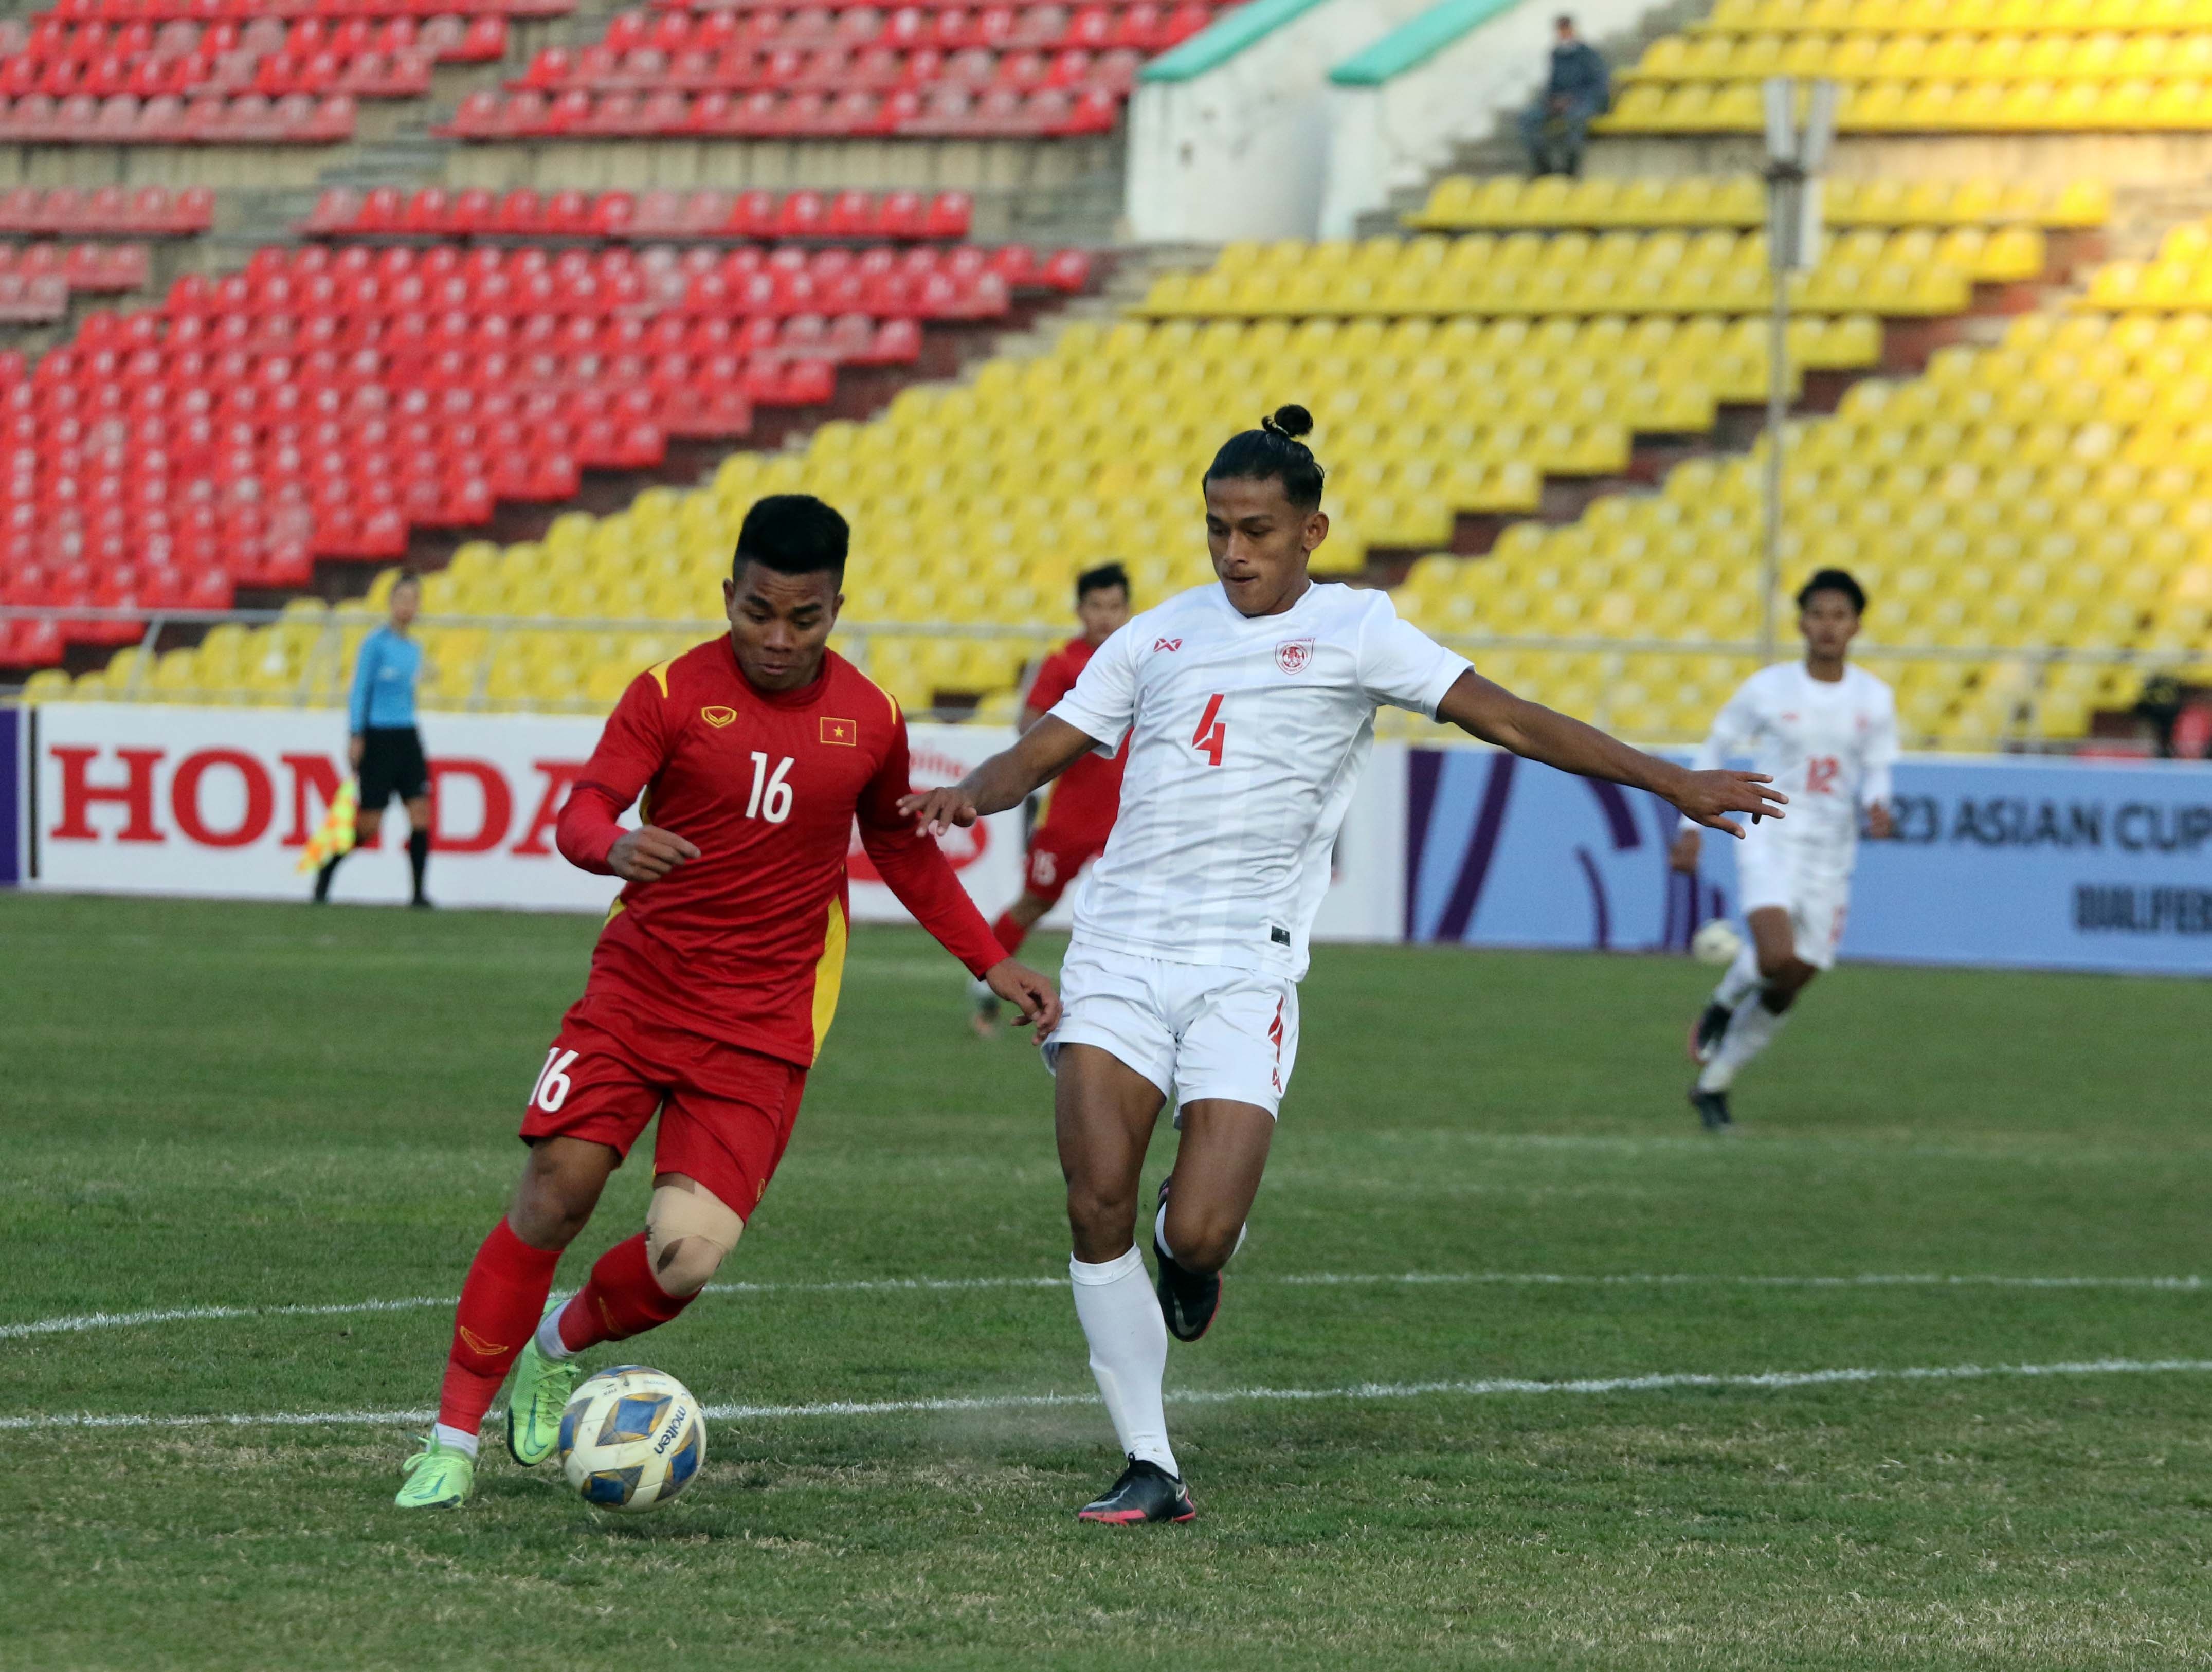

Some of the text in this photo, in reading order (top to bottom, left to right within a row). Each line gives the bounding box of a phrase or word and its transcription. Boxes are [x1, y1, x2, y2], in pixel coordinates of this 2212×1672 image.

[1192, 693, 1226, 766] 4
[746, 751, 795, 823] 16
[1805, 756, 1840, 794] 12
[1954, 797, 2104, 849] ASIAN
[2113, 802, 2212, 856] CUP
[529, 1047, 579, 1112] 16
[654, 1405, 687, 1455] molten
